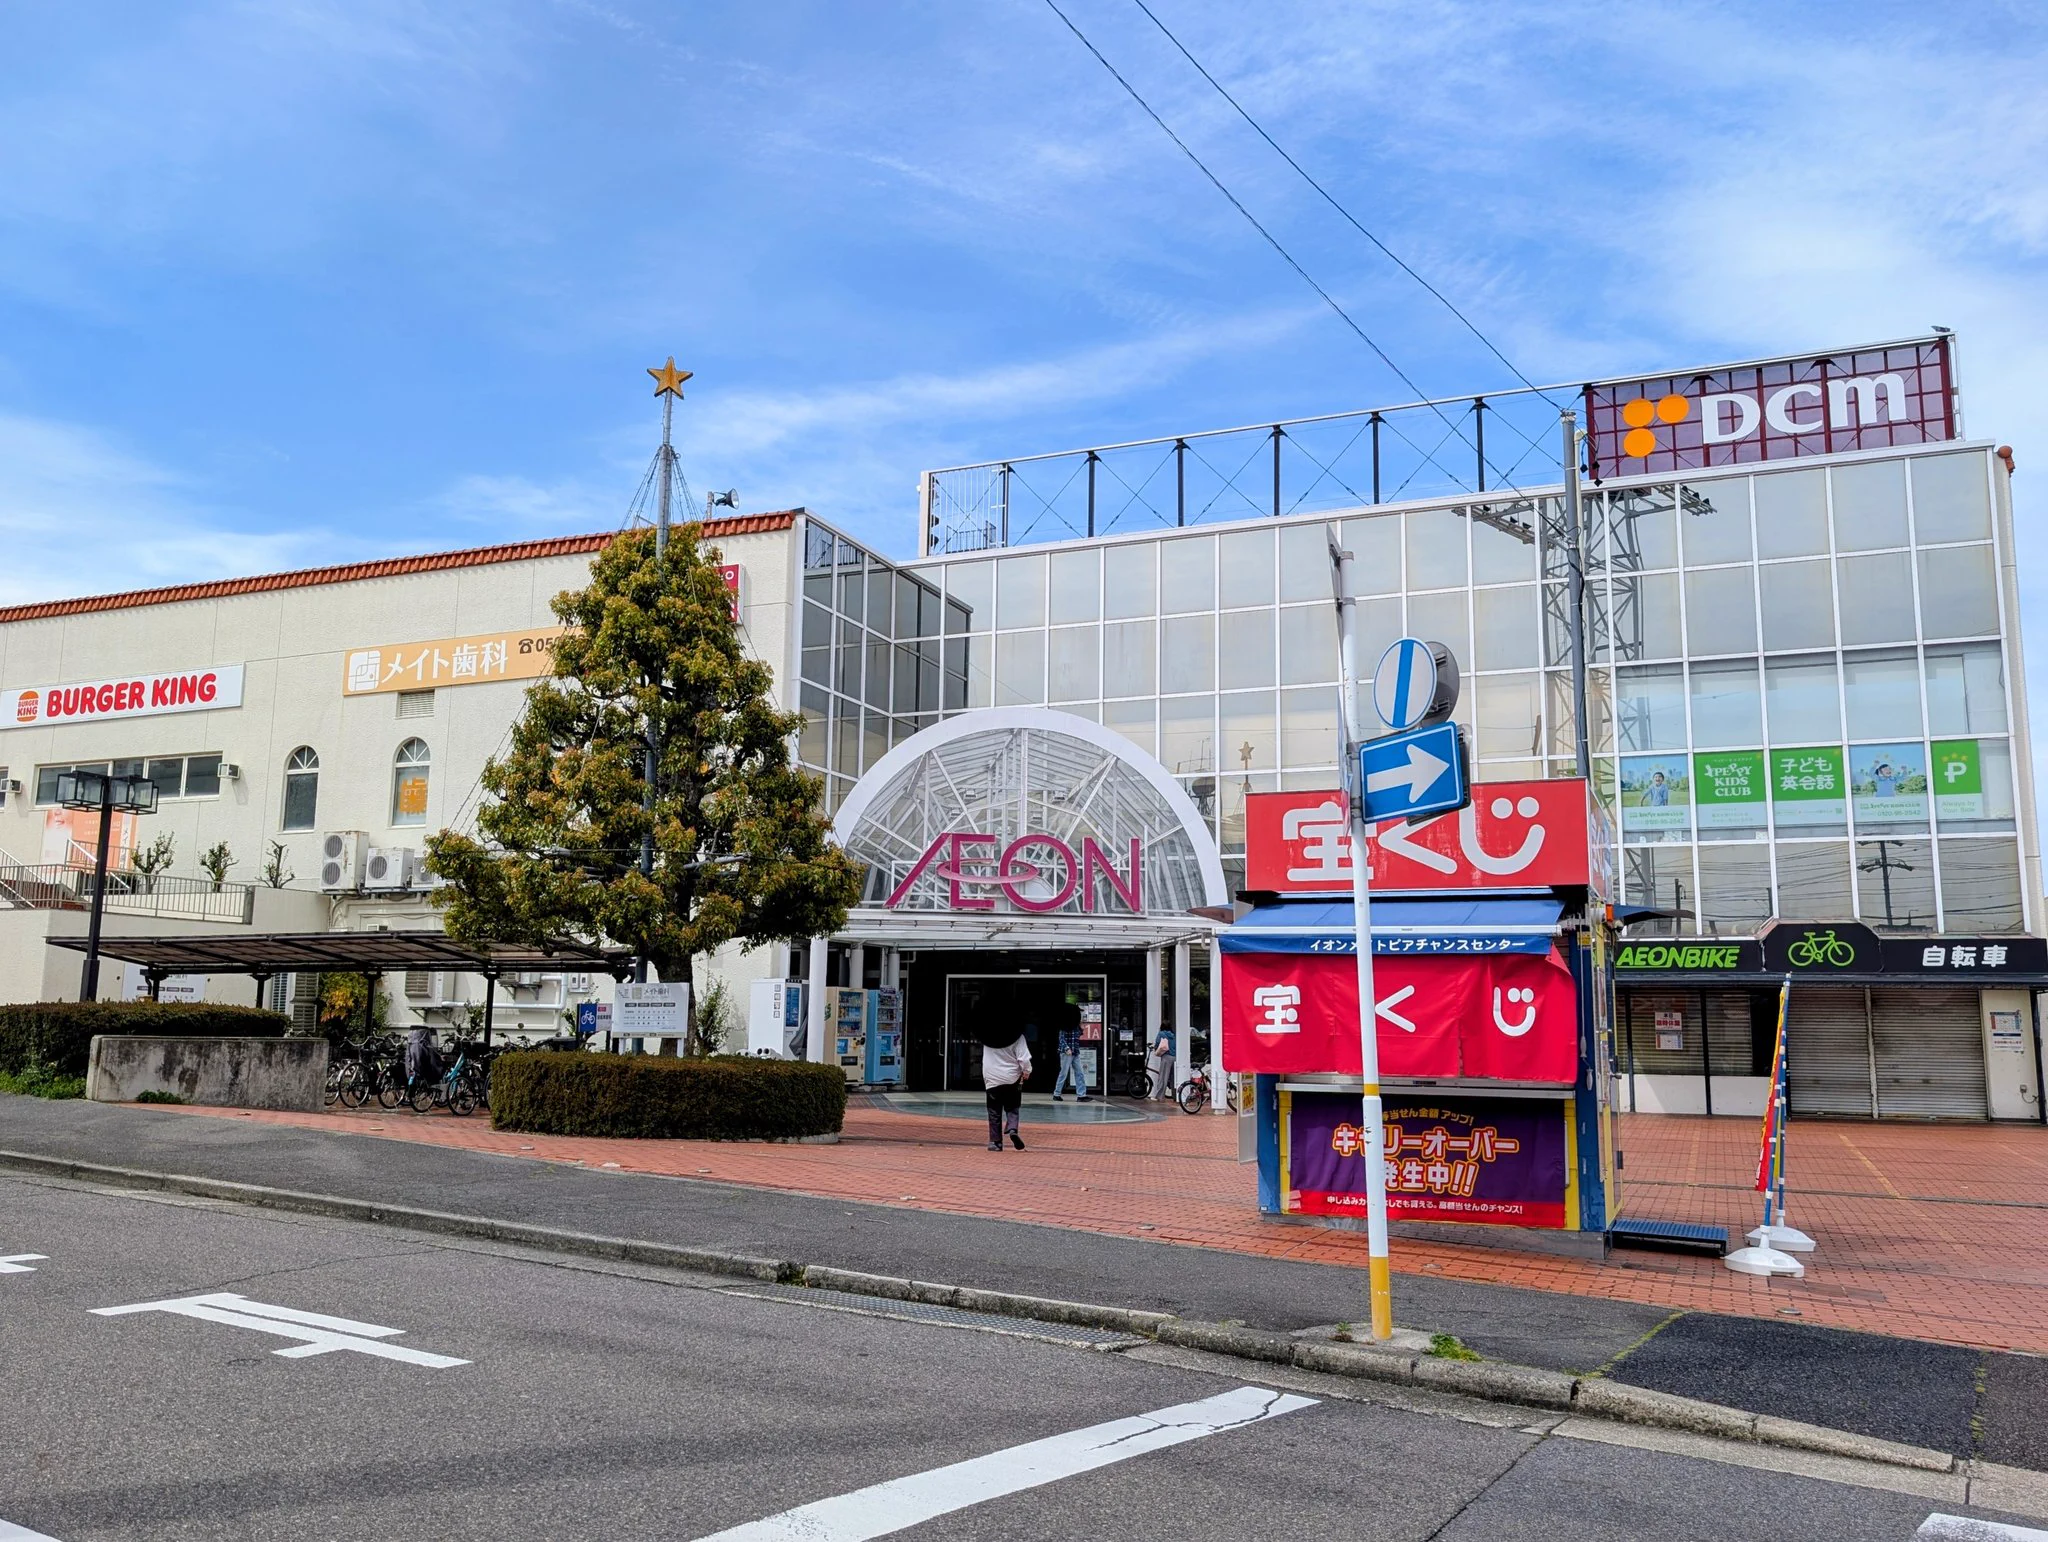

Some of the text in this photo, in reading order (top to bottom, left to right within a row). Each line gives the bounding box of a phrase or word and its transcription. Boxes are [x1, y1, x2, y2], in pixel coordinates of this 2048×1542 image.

[381, 639, 508, 684] メイト歯科
[18, 699, 39, 708] BURGER
[46, 672, 217, 718] BURGER KING
[17, 706, 38, 716] KING
[1714, 763, 1752, 777] PEPPY
[1780, 756, 1833, 773] 子ども
[1714, 776, 1749, 787] KIDS
[1780, 774, 1835, 791] 英会話
[1714, 787, 1752, 796] CLUB
[1282, 796, 1546, 882] 宝くじ
[1310, 938, 1526, 952] イオンメトピアチャンスセンター
[1616, 945, 1741, 968] AEONBIKE
[1922, 945, 2009, 968] 自転車
[1253, 984, 1536, 1037] 宝くじ
